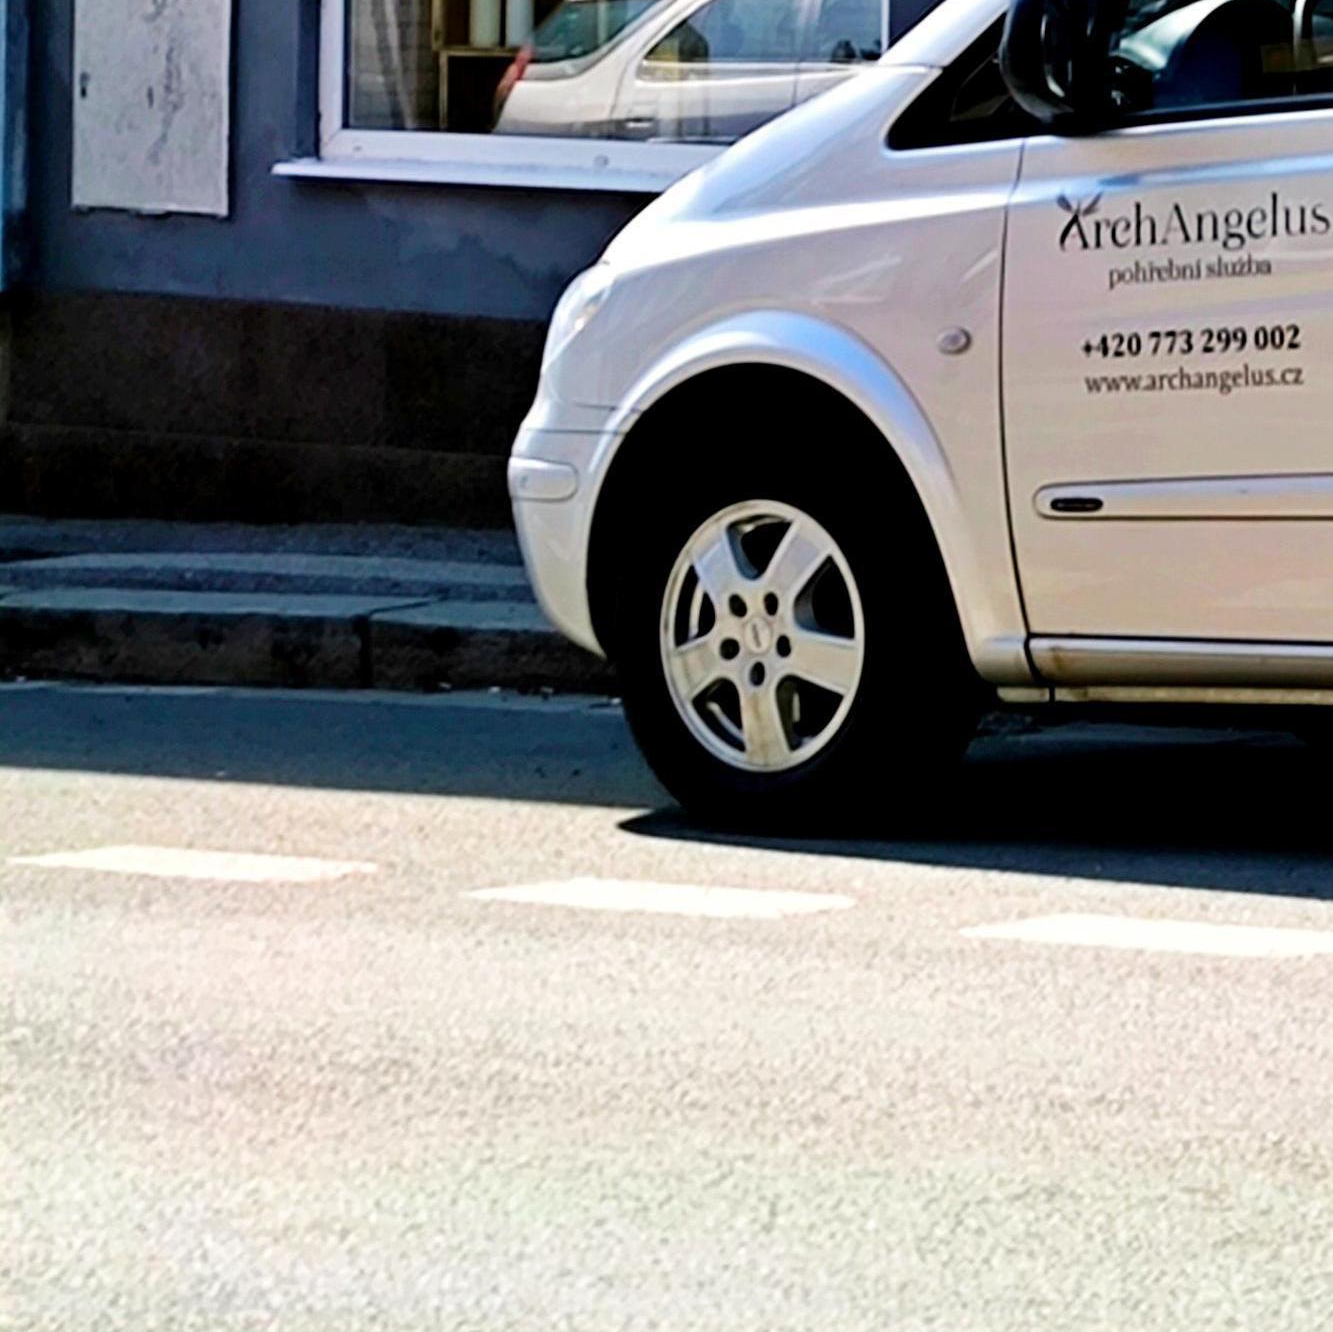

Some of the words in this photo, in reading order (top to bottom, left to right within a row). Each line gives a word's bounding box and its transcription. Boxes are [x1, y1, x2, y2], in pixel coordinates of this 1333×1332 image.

[1056, 191, 1331, 252] ArchAngelus
[1108, 254, 1202, 290] pohřební
[1081, 332, 1142, 358] +420
[1147, 329, 1194, 356] 773
[1200, 327, 1248, 353] 299
[1253, 324, 1301, 351] 002
[1084, 362, 1305, 396] www.archangelus.cz
